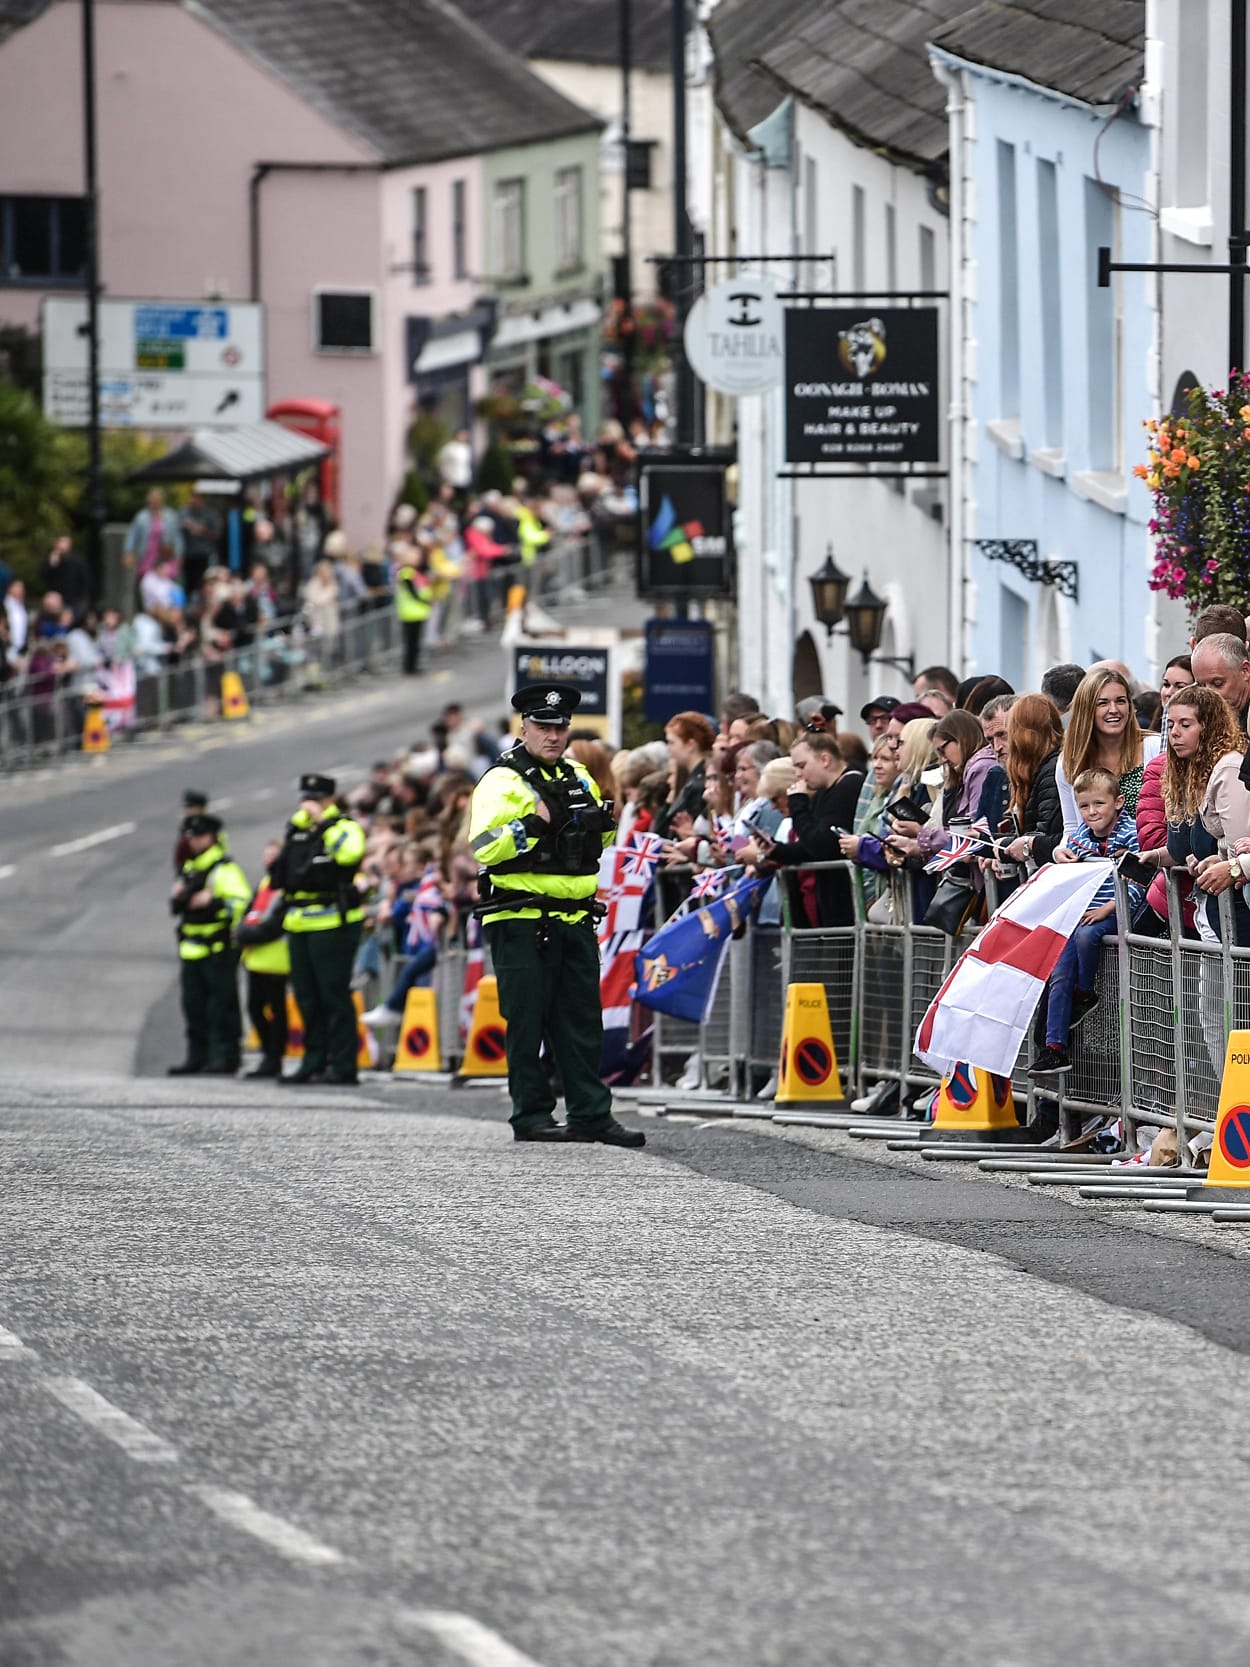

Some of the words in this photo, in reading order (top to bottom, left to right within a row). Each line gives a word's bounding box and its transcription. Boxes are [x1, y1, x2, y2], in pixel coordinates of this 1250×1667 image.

[827, 406, 871, 418] MAKE
[874, 406, 897, 418] UP
[804, 422, 842, 435] HAIR
[844, 423, 856, 435] &
[859, 422, 919, 435] BEAUTY
